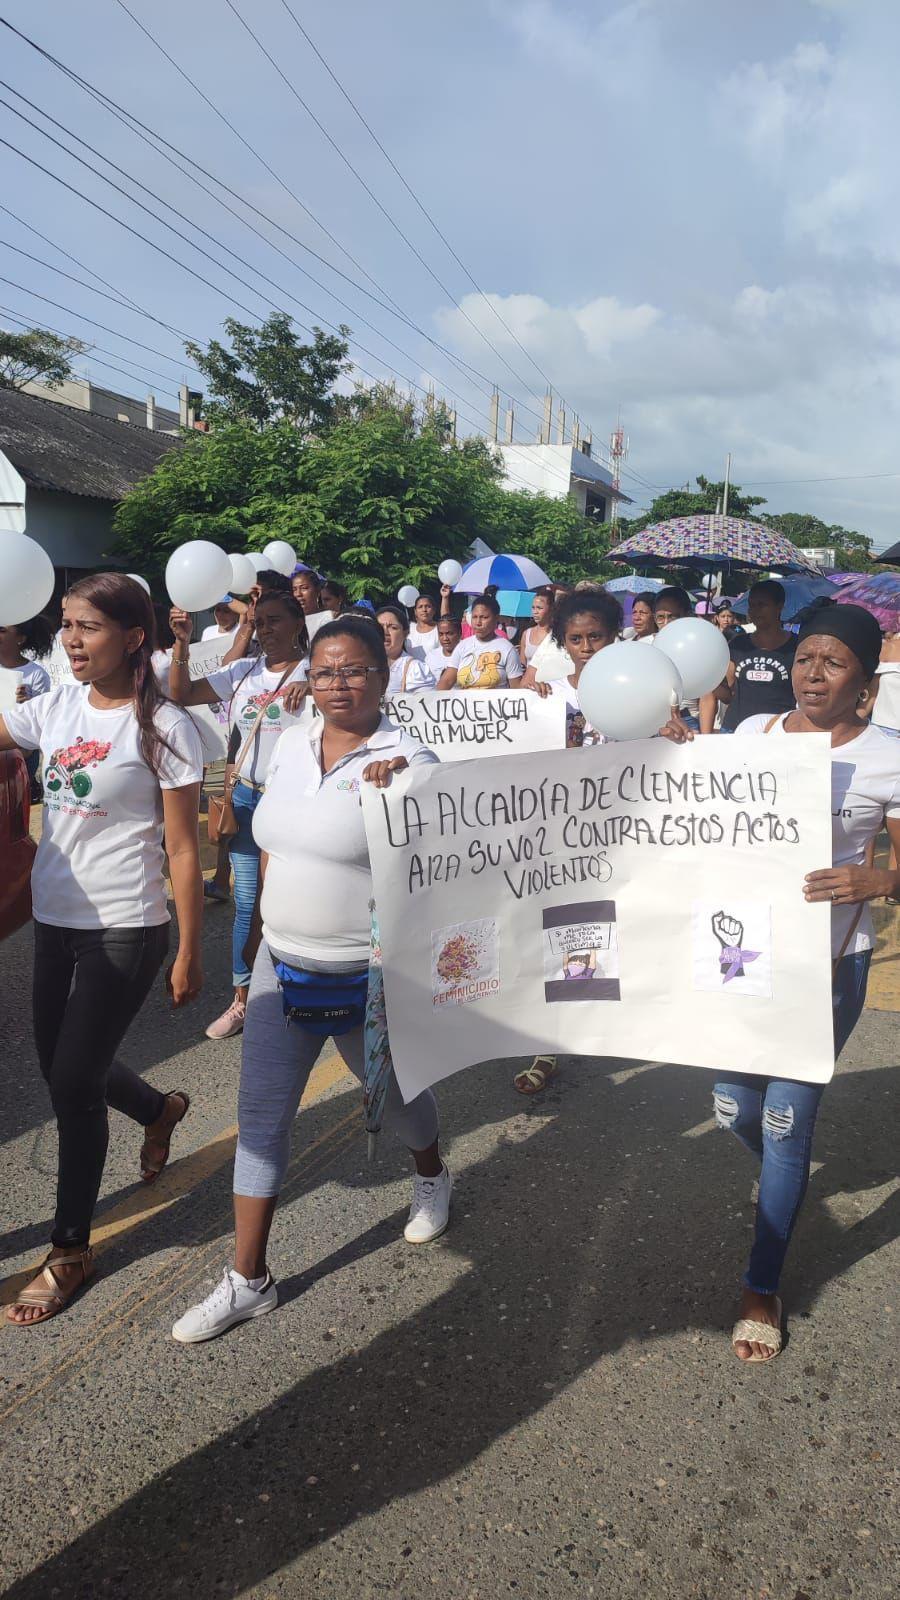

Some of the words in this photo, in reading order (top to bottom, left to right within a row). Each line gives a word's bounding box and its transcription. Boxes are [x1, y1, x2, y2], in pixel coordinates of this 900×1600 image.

[418, 697, 529, 723] VIOLENCIA
[447, 719, 513, 744] MUJER
[381, 793, 430, 848] LA
[578, 776, 613, 812] DE
[468, 840, 502, 875] SU
[562, 814, 657, 849] CONTRA
[432, 978, 500, 1006] FEMINICIDIO
